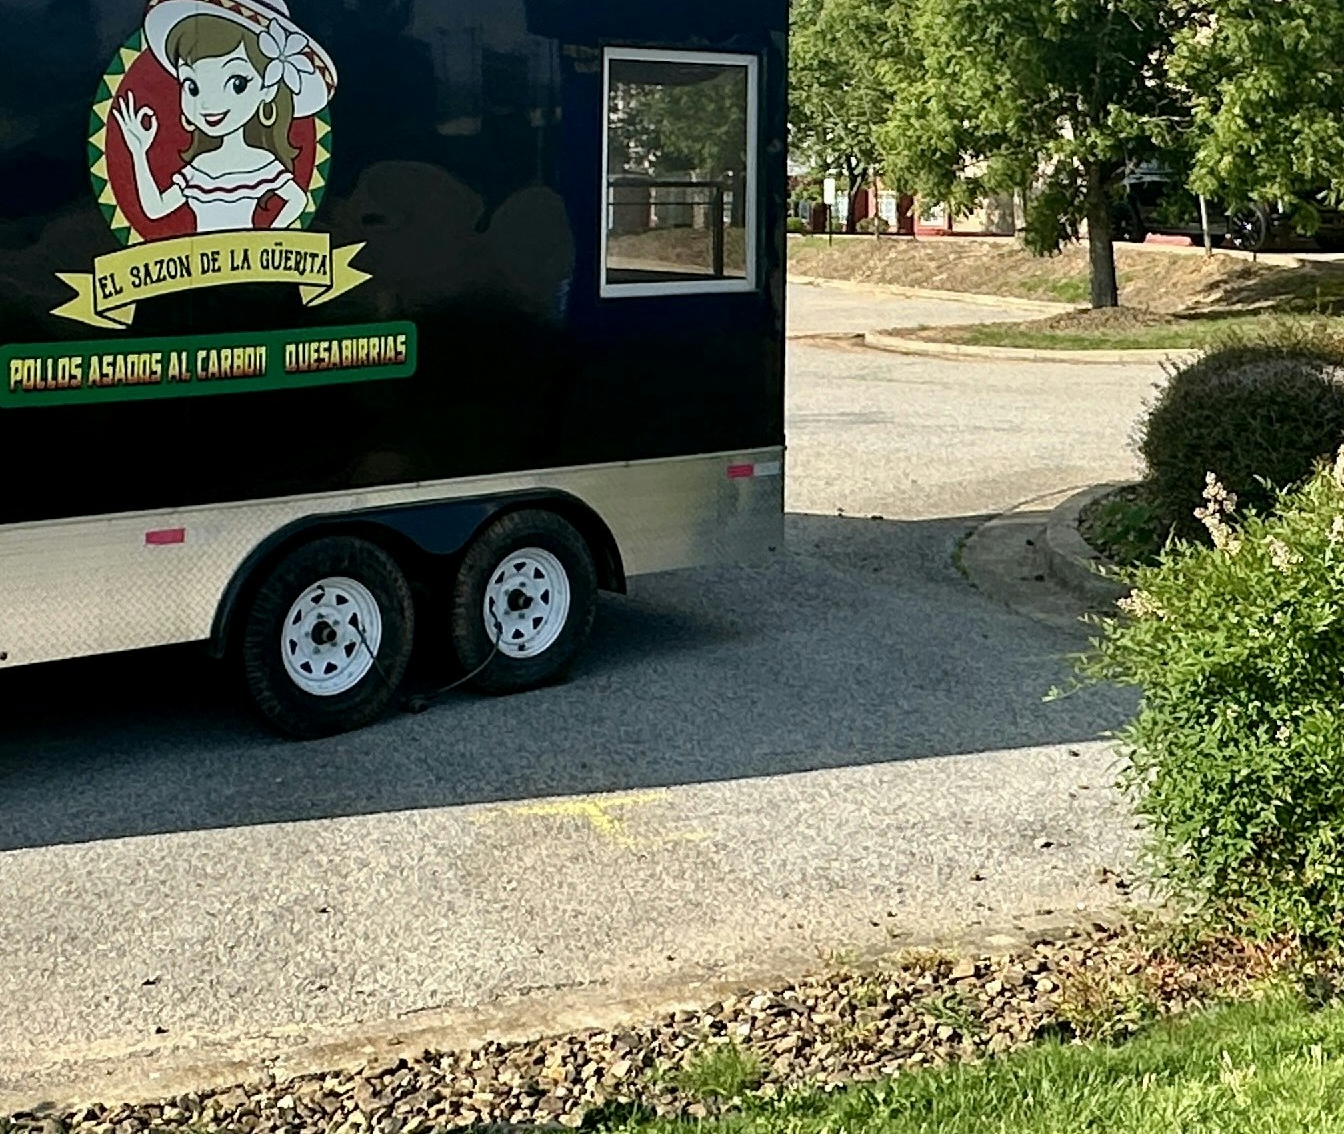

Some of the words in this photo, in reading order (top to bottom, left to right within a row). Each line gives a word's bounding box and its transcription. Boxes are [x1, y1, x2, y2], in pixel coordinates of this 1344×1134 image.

[98, 272, 123, 300] EL
[130, 254, 193, 288] SAZON
[200, 250, 222, 275] DE
[230, 248, 252, 272] LA
[260, 241, 328, 277] GÜERITA
[9, 356, 83, 391] POLLOS
[88, 351, 163, 387] ASADOS
[167, 351, 192, 382] AL
[196, 345, 267, 380] CARBON
[284, 334, 407, 372] QUESABIRRIAS
